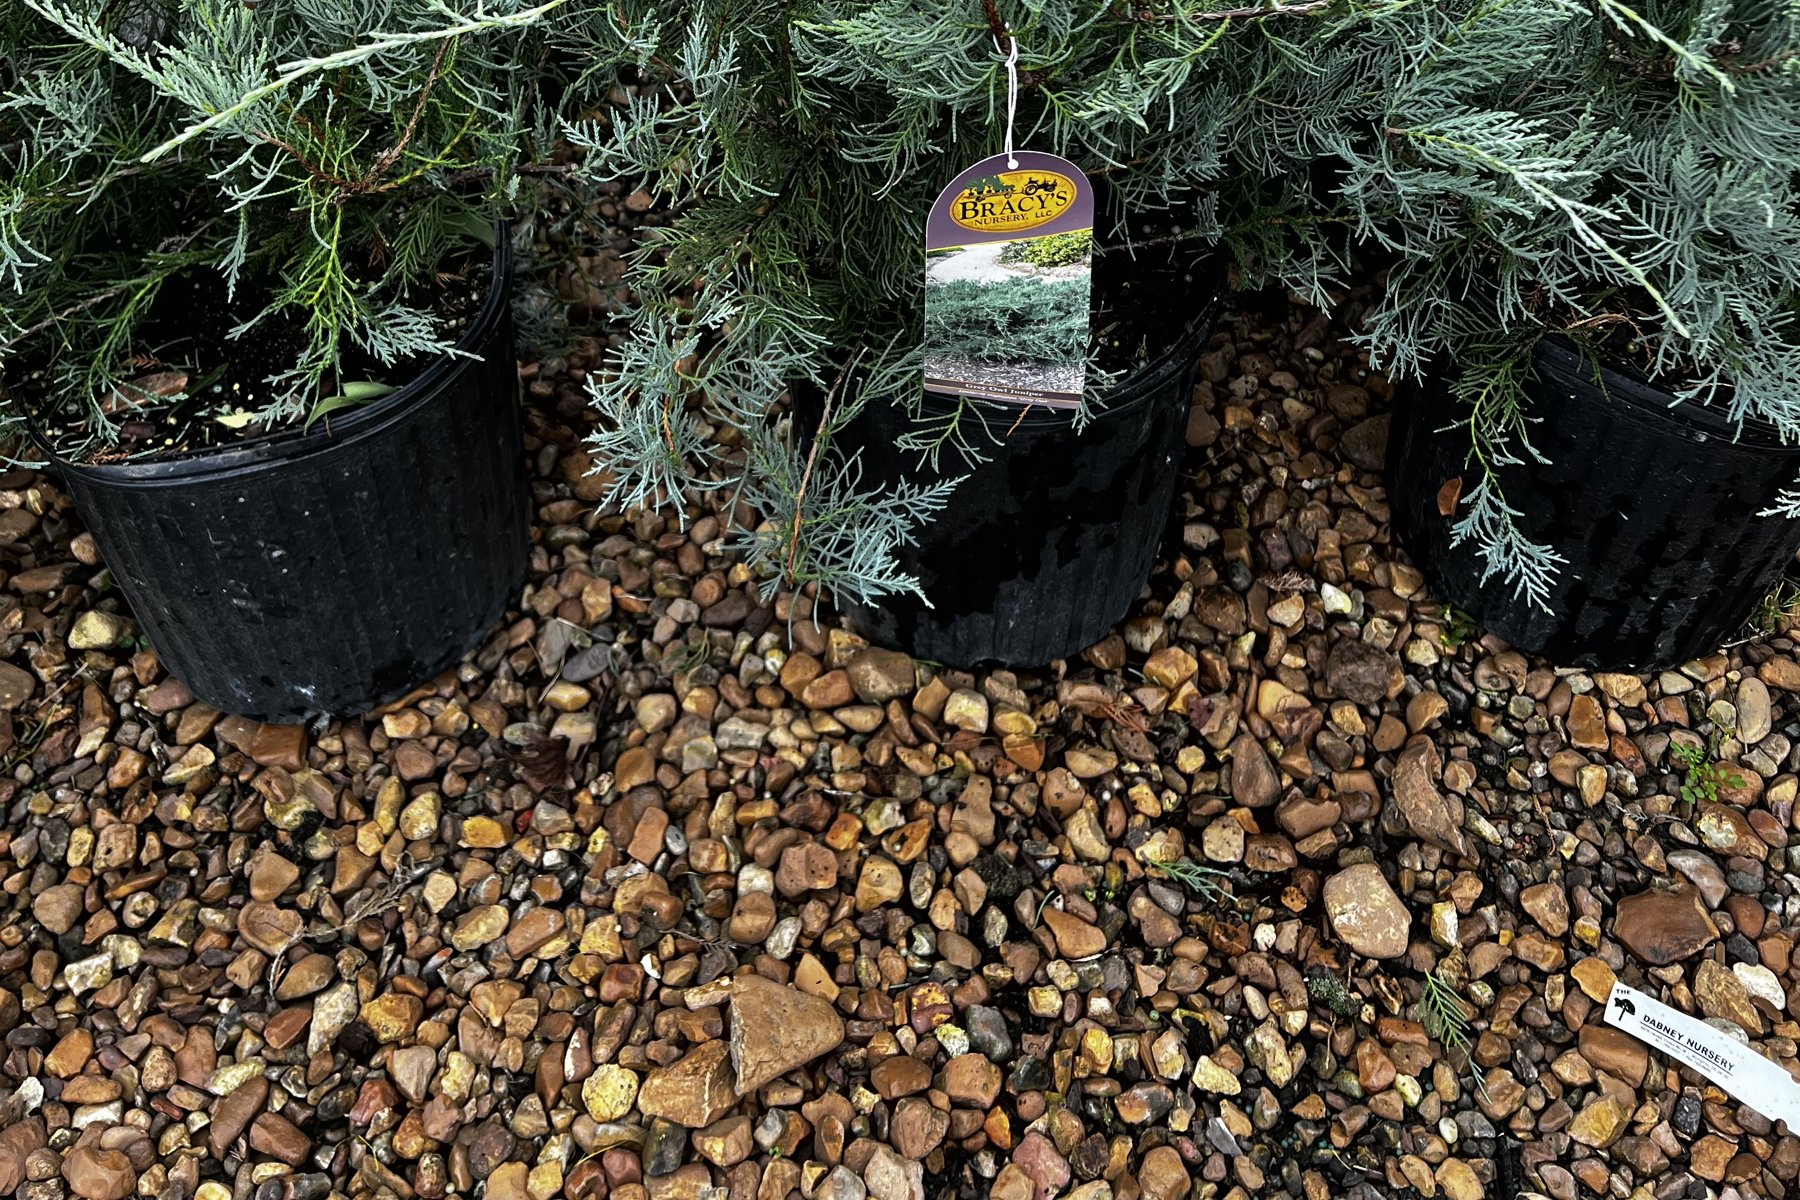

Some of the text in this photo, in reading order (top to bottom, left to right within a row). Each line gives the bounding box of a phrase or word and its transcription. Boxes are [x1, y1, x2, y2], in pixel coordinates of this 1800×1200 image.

[960, 191, 1067, 220] BRACY'S
[1035, 210, 1052, 218] LLC
[1010, 389, 1044, 397] Juniper
[1643, 1015, 1684, 1040] DABNEY
[1687, 1039, 1734, 1071] NURSERY
